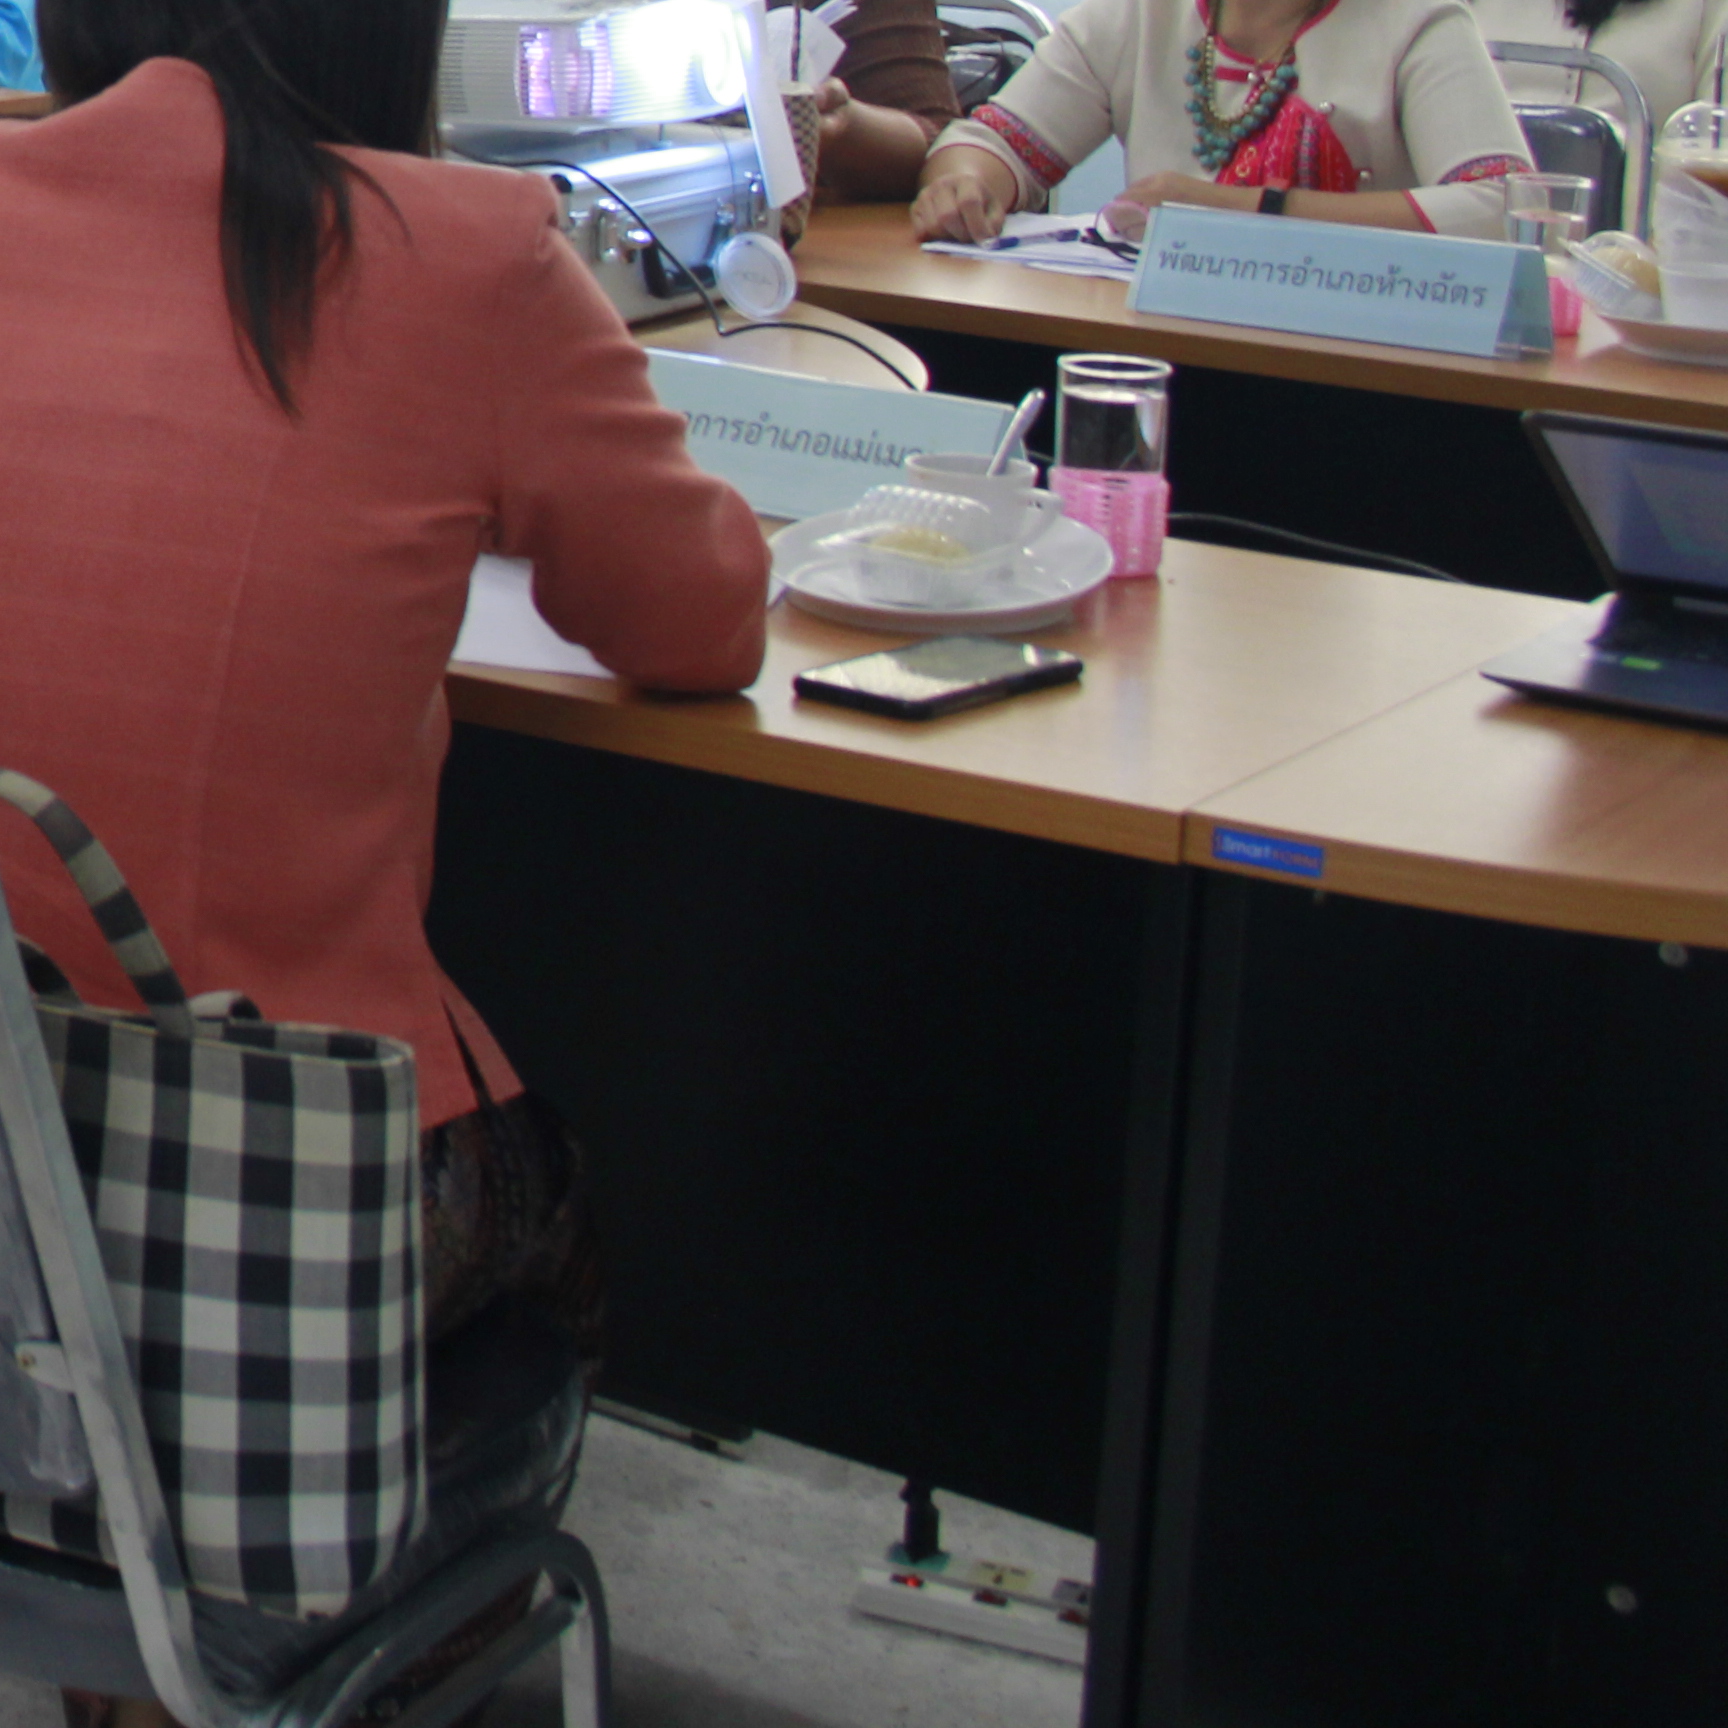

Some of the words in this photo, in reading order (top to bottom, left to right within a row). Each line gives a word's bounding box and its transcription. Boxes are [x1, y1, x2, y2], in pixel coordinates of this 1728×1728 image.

[1158, 241, 1488, 309] พัฒนาการอำเภอห้างฉัตร
